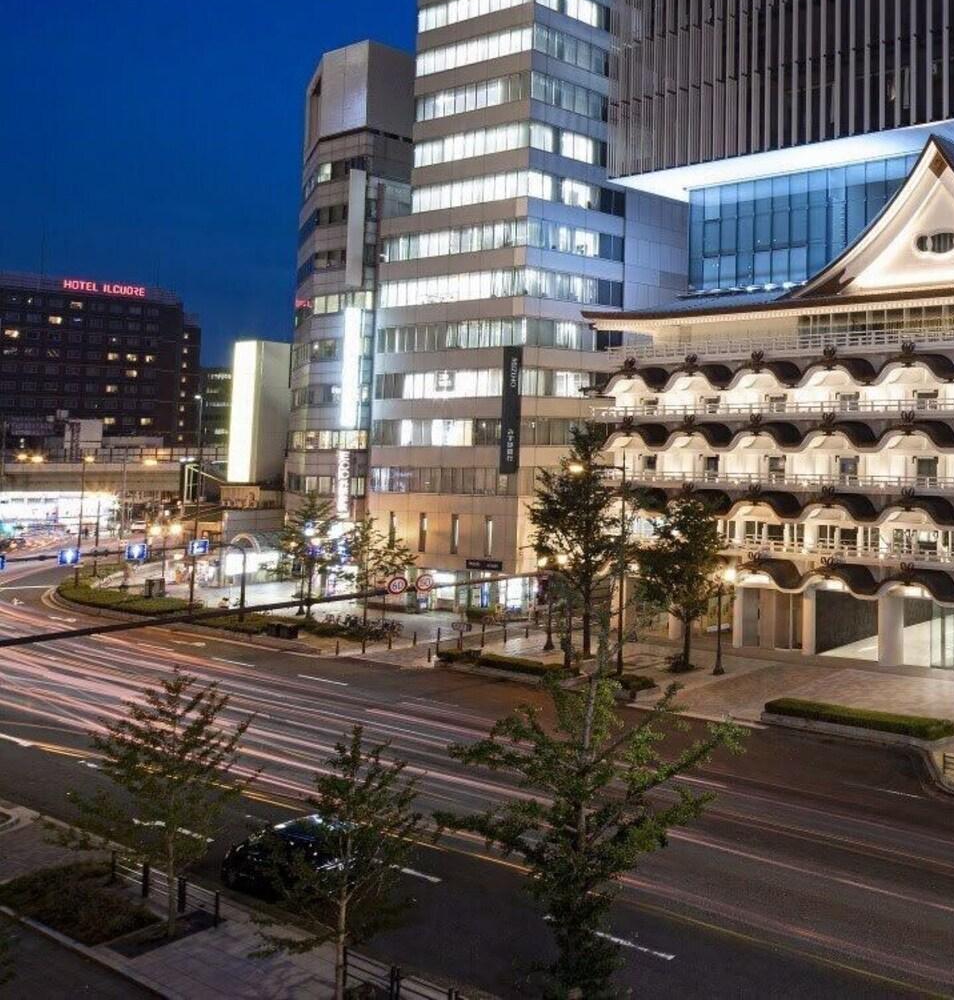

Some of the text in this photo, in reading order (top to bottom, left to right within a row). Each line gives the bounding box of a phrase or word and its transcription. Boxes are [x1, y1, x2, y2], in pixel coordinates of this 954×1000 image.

[63, 279, 145, 297] HOTEL ILCUORE
[510, 357, 518, 388] MIZUHO
